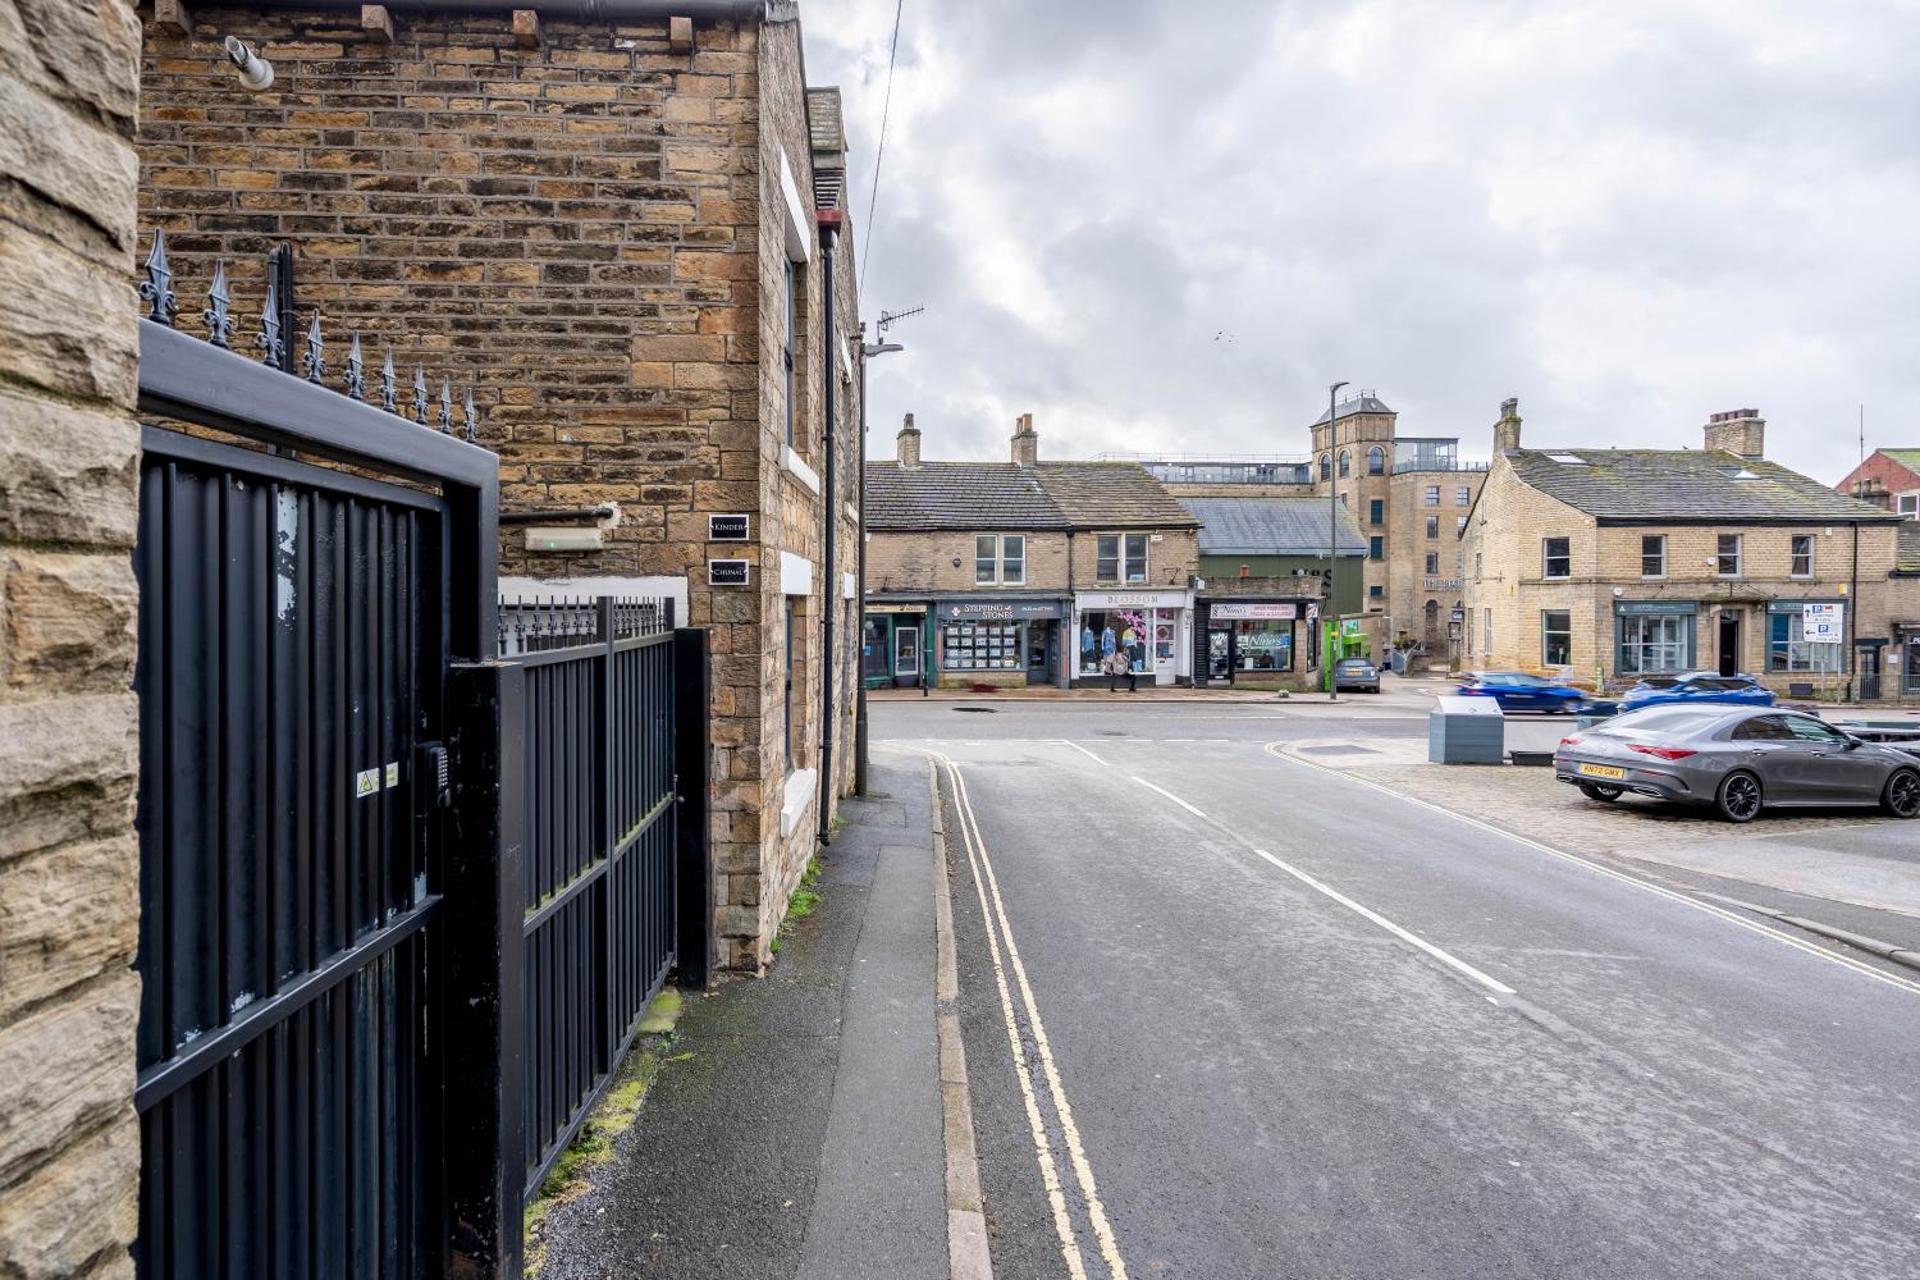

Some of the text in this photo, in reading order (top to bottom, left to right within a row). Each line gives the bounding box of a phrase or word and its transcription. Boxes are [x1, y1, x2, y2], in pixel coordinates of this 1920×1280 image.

[714, 523, 744, 531] KINDER
[1107, 595, 1158, 604] BLOSSOM
[982, 611, 1014, 619] STONES
